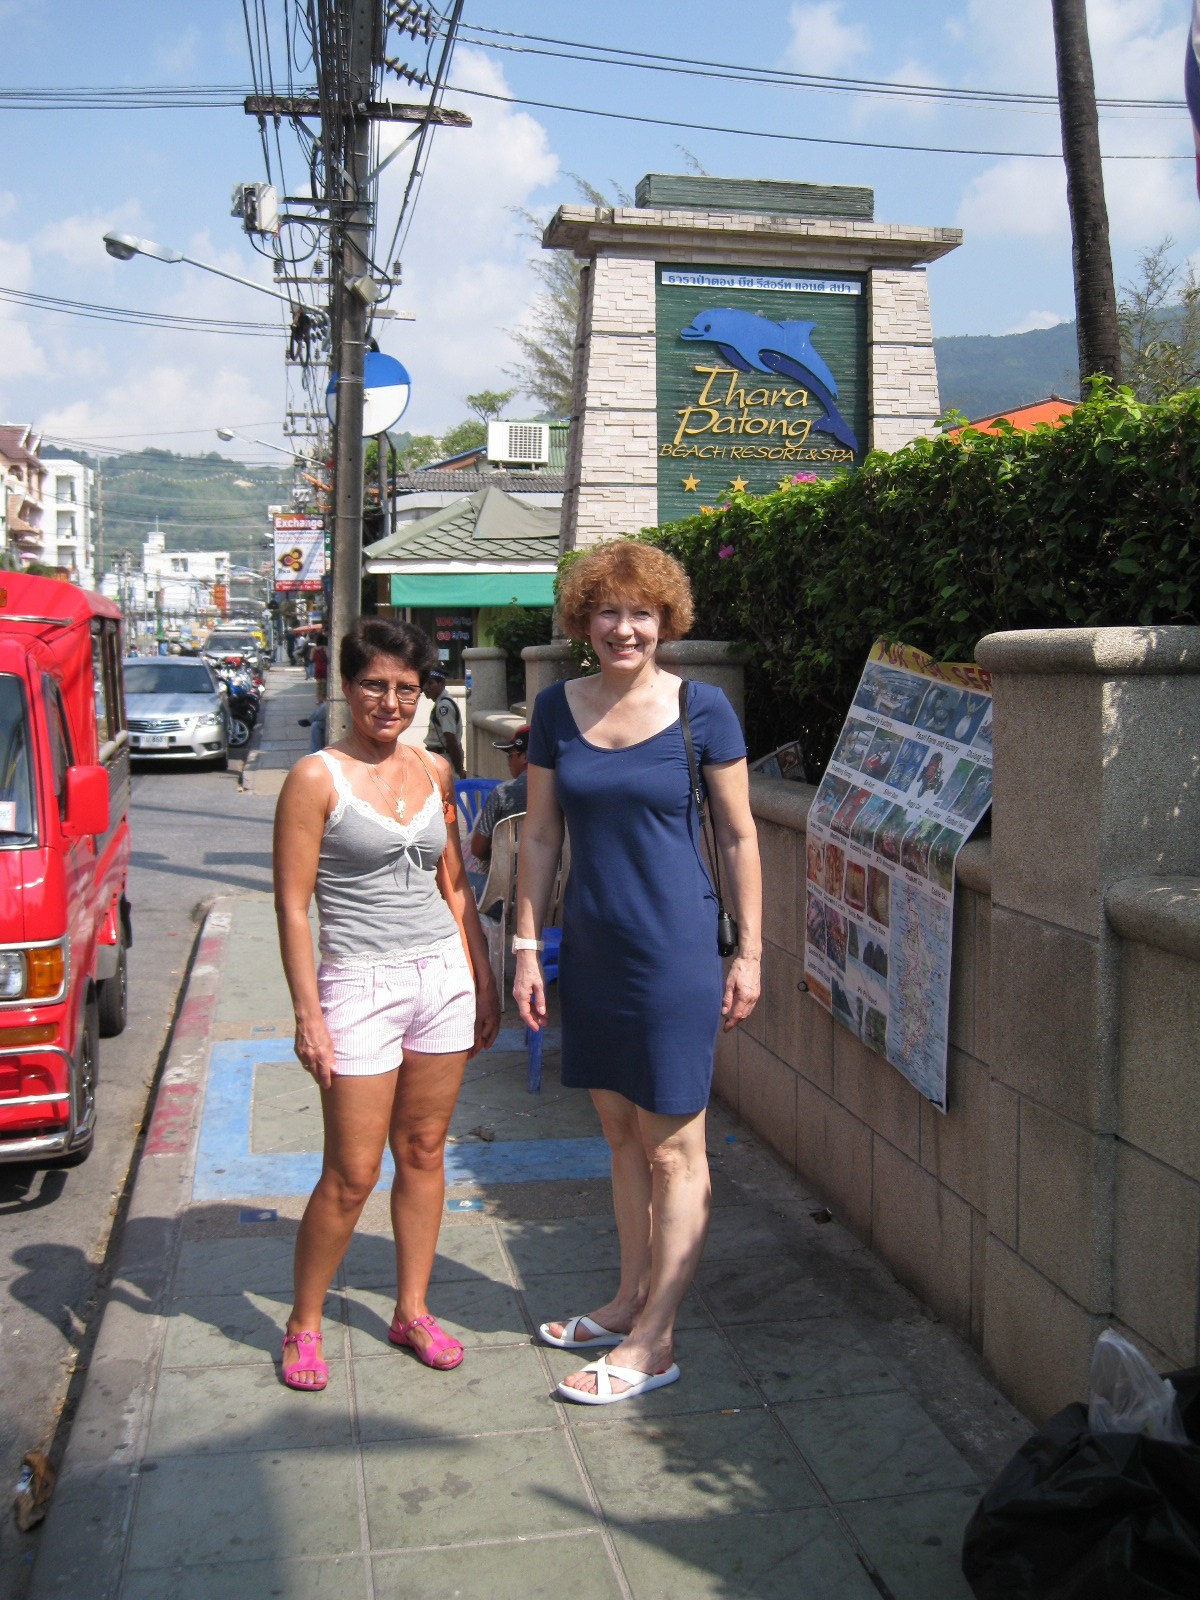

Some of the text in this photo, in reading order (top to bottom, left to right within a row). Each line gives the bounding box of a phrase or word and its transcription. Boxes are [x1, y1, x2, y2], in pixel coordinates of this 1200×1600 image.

[794, 280, 826, 292] แอนด์
[829, 283, 851, 293] สปา
[694, 365, 808, 408] Thara
[673, 406, 812, 448] Patong
[659, 444, 726, 459] BEACH
[275, 518, 324, 530] Exchange
